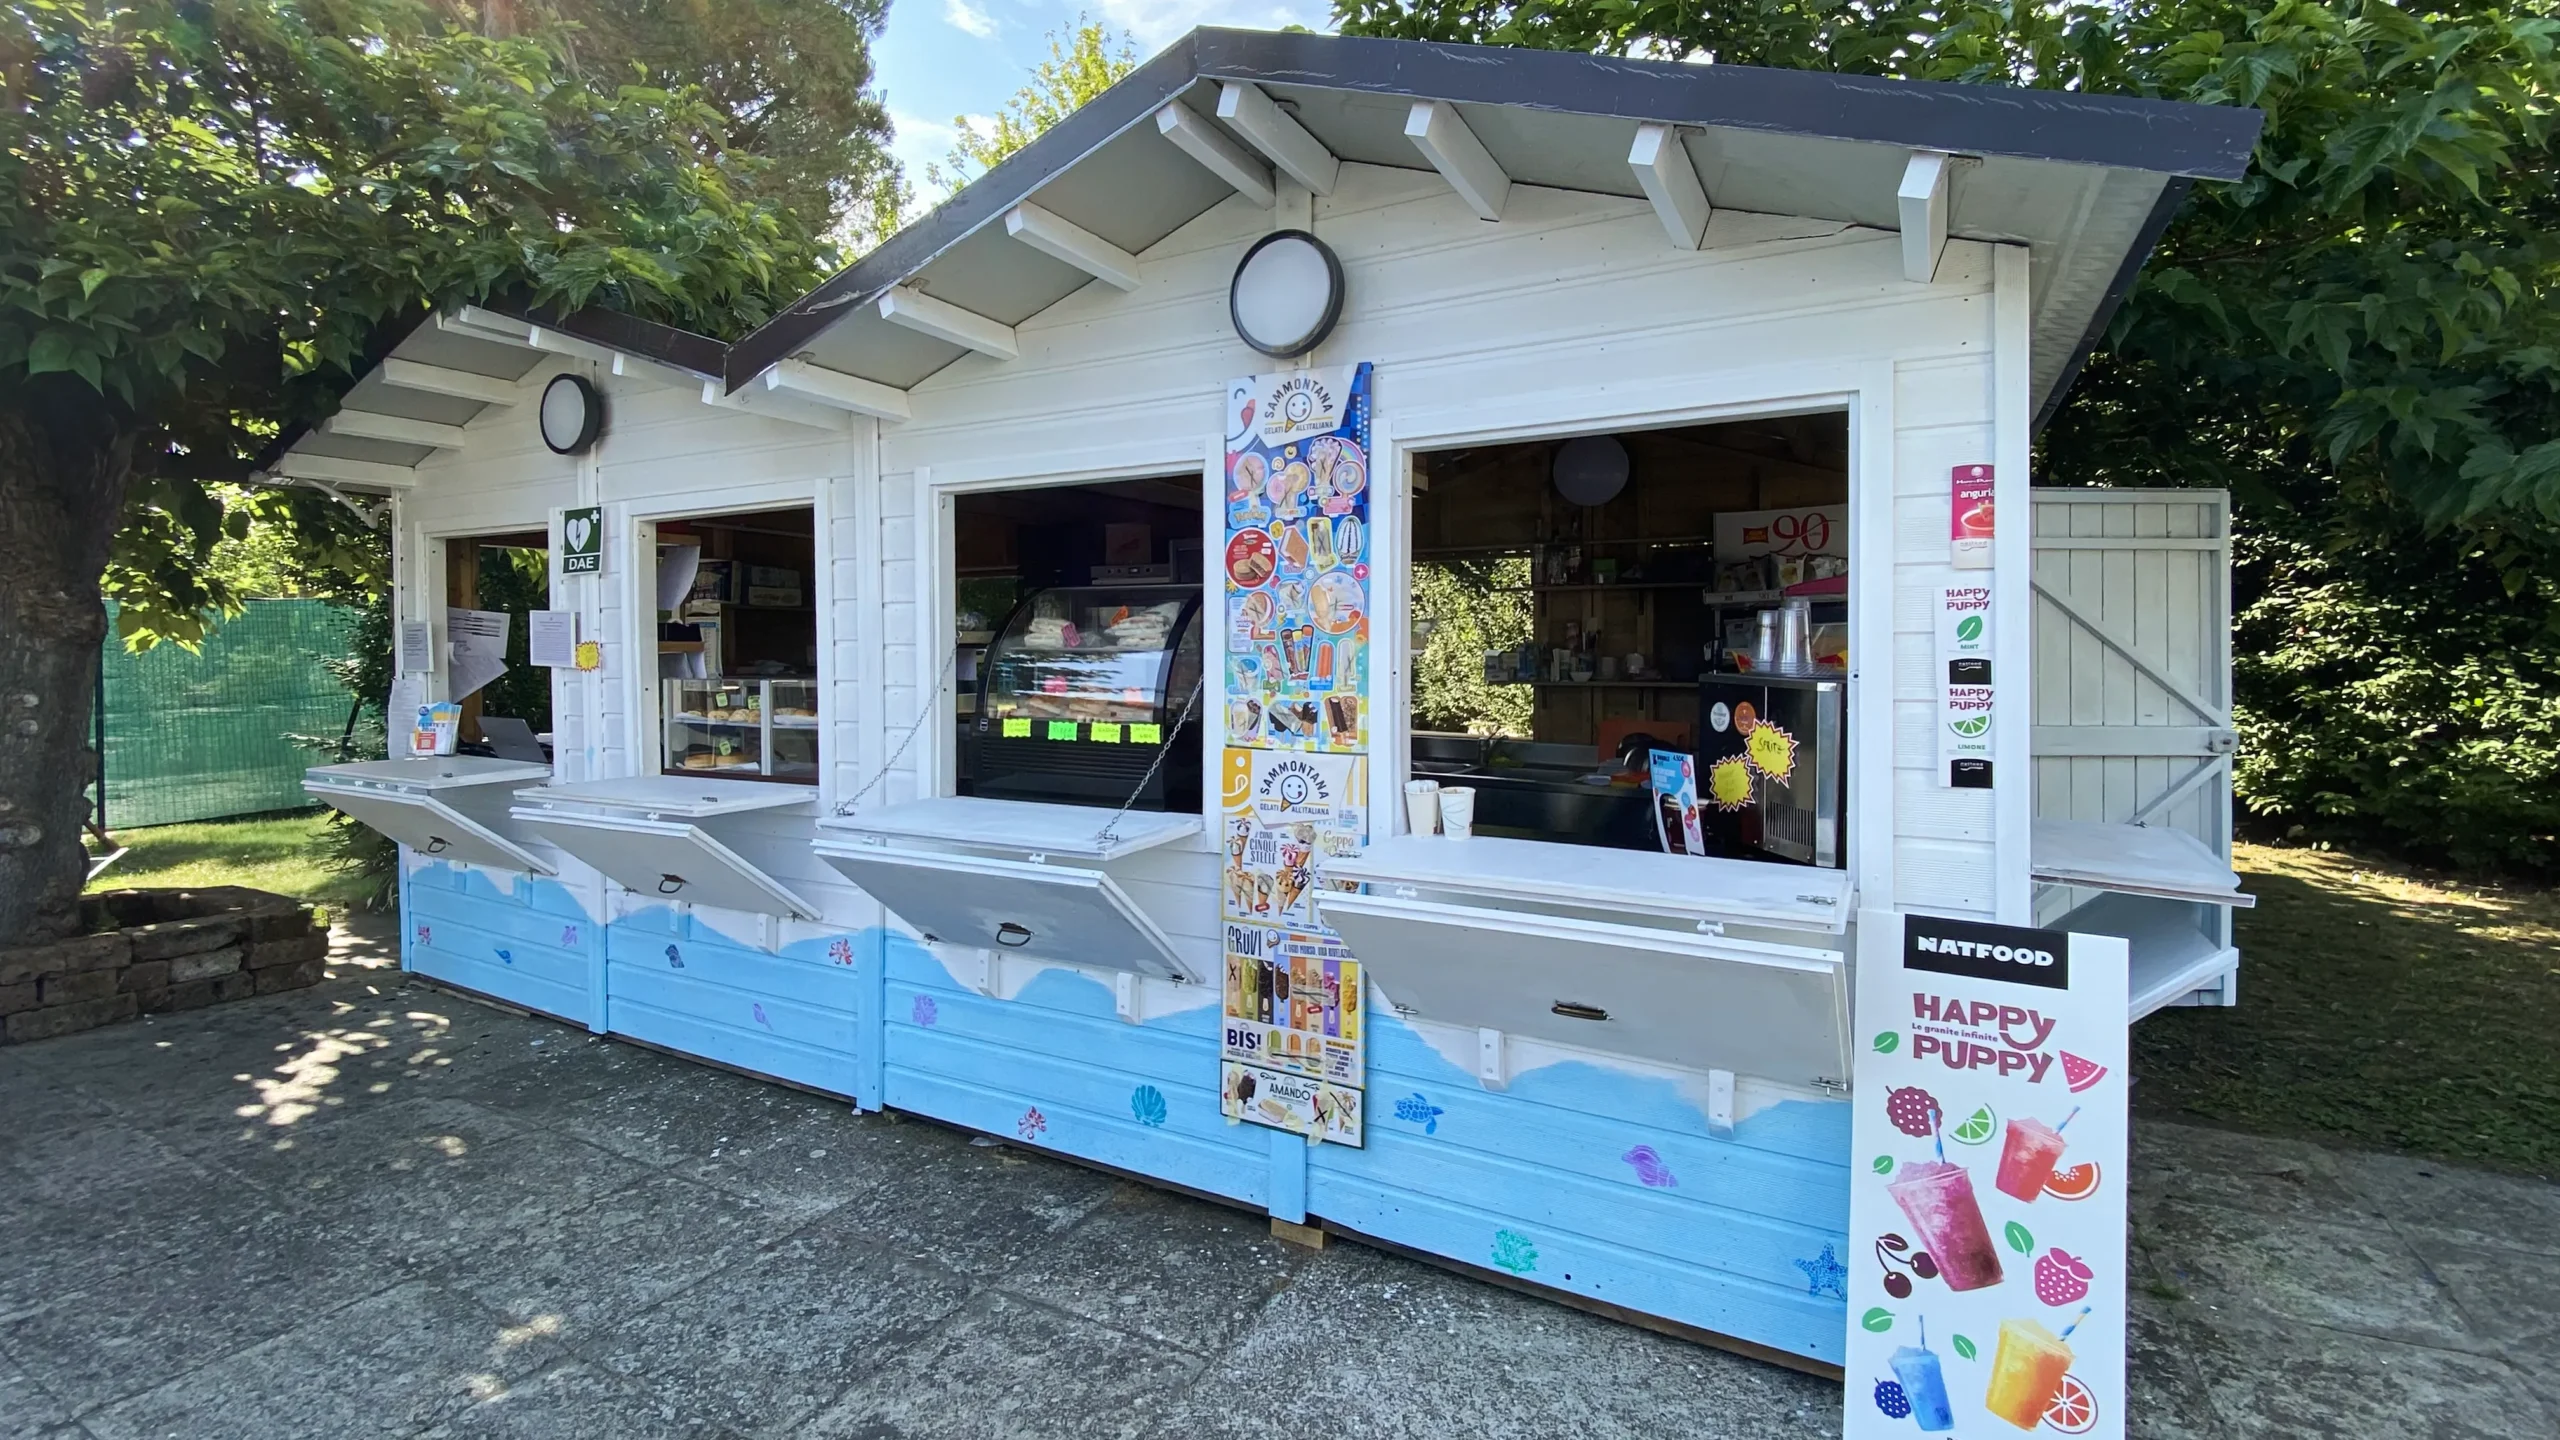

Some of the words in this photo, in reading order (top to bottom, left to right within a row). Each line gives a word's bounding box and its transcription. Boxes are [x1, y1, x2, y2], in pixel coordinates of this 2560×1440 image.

[1265, 378, 1333, 419] SAMMONTANA
[1264, 426, 1283, 434] GELATI
[1295, 422, 1333, 431] ALL'ITALIANA
[568, 556, 594, 570] DAE
[1946, 588, 1990, 601] HAPPY
[1946, 601, 1990, 610] PUPPY
[1949, 688, 1994, 702] HAPPY
[1949, 701, 1993, 711] PUPPY
[1260, 760, 1330, 800] SAMMONTANA
[1260, 803, 1279, 811] GELATI
[1291, 805, 1330, 816] ALL'ITALIANA
[1249, 839, 1277, 852] CINQUE
[1250, 851, 1276, 864] STELLE
[1917, 936, 2054, 967] NATFOOD
[1913, 993, 2056, 1051] HAPPY
[1912, 1022, 1922, 1030] Le
[1924, 1026, 1960, 1037] granite
[1961, 1030, 1998, 1042] infinite
[1227, 1028, 1261, 1051] BIS!
[1913, 1034, 2054, 1083] PUPPY
[1269, 1083, 1311, 1101] AMANDO
